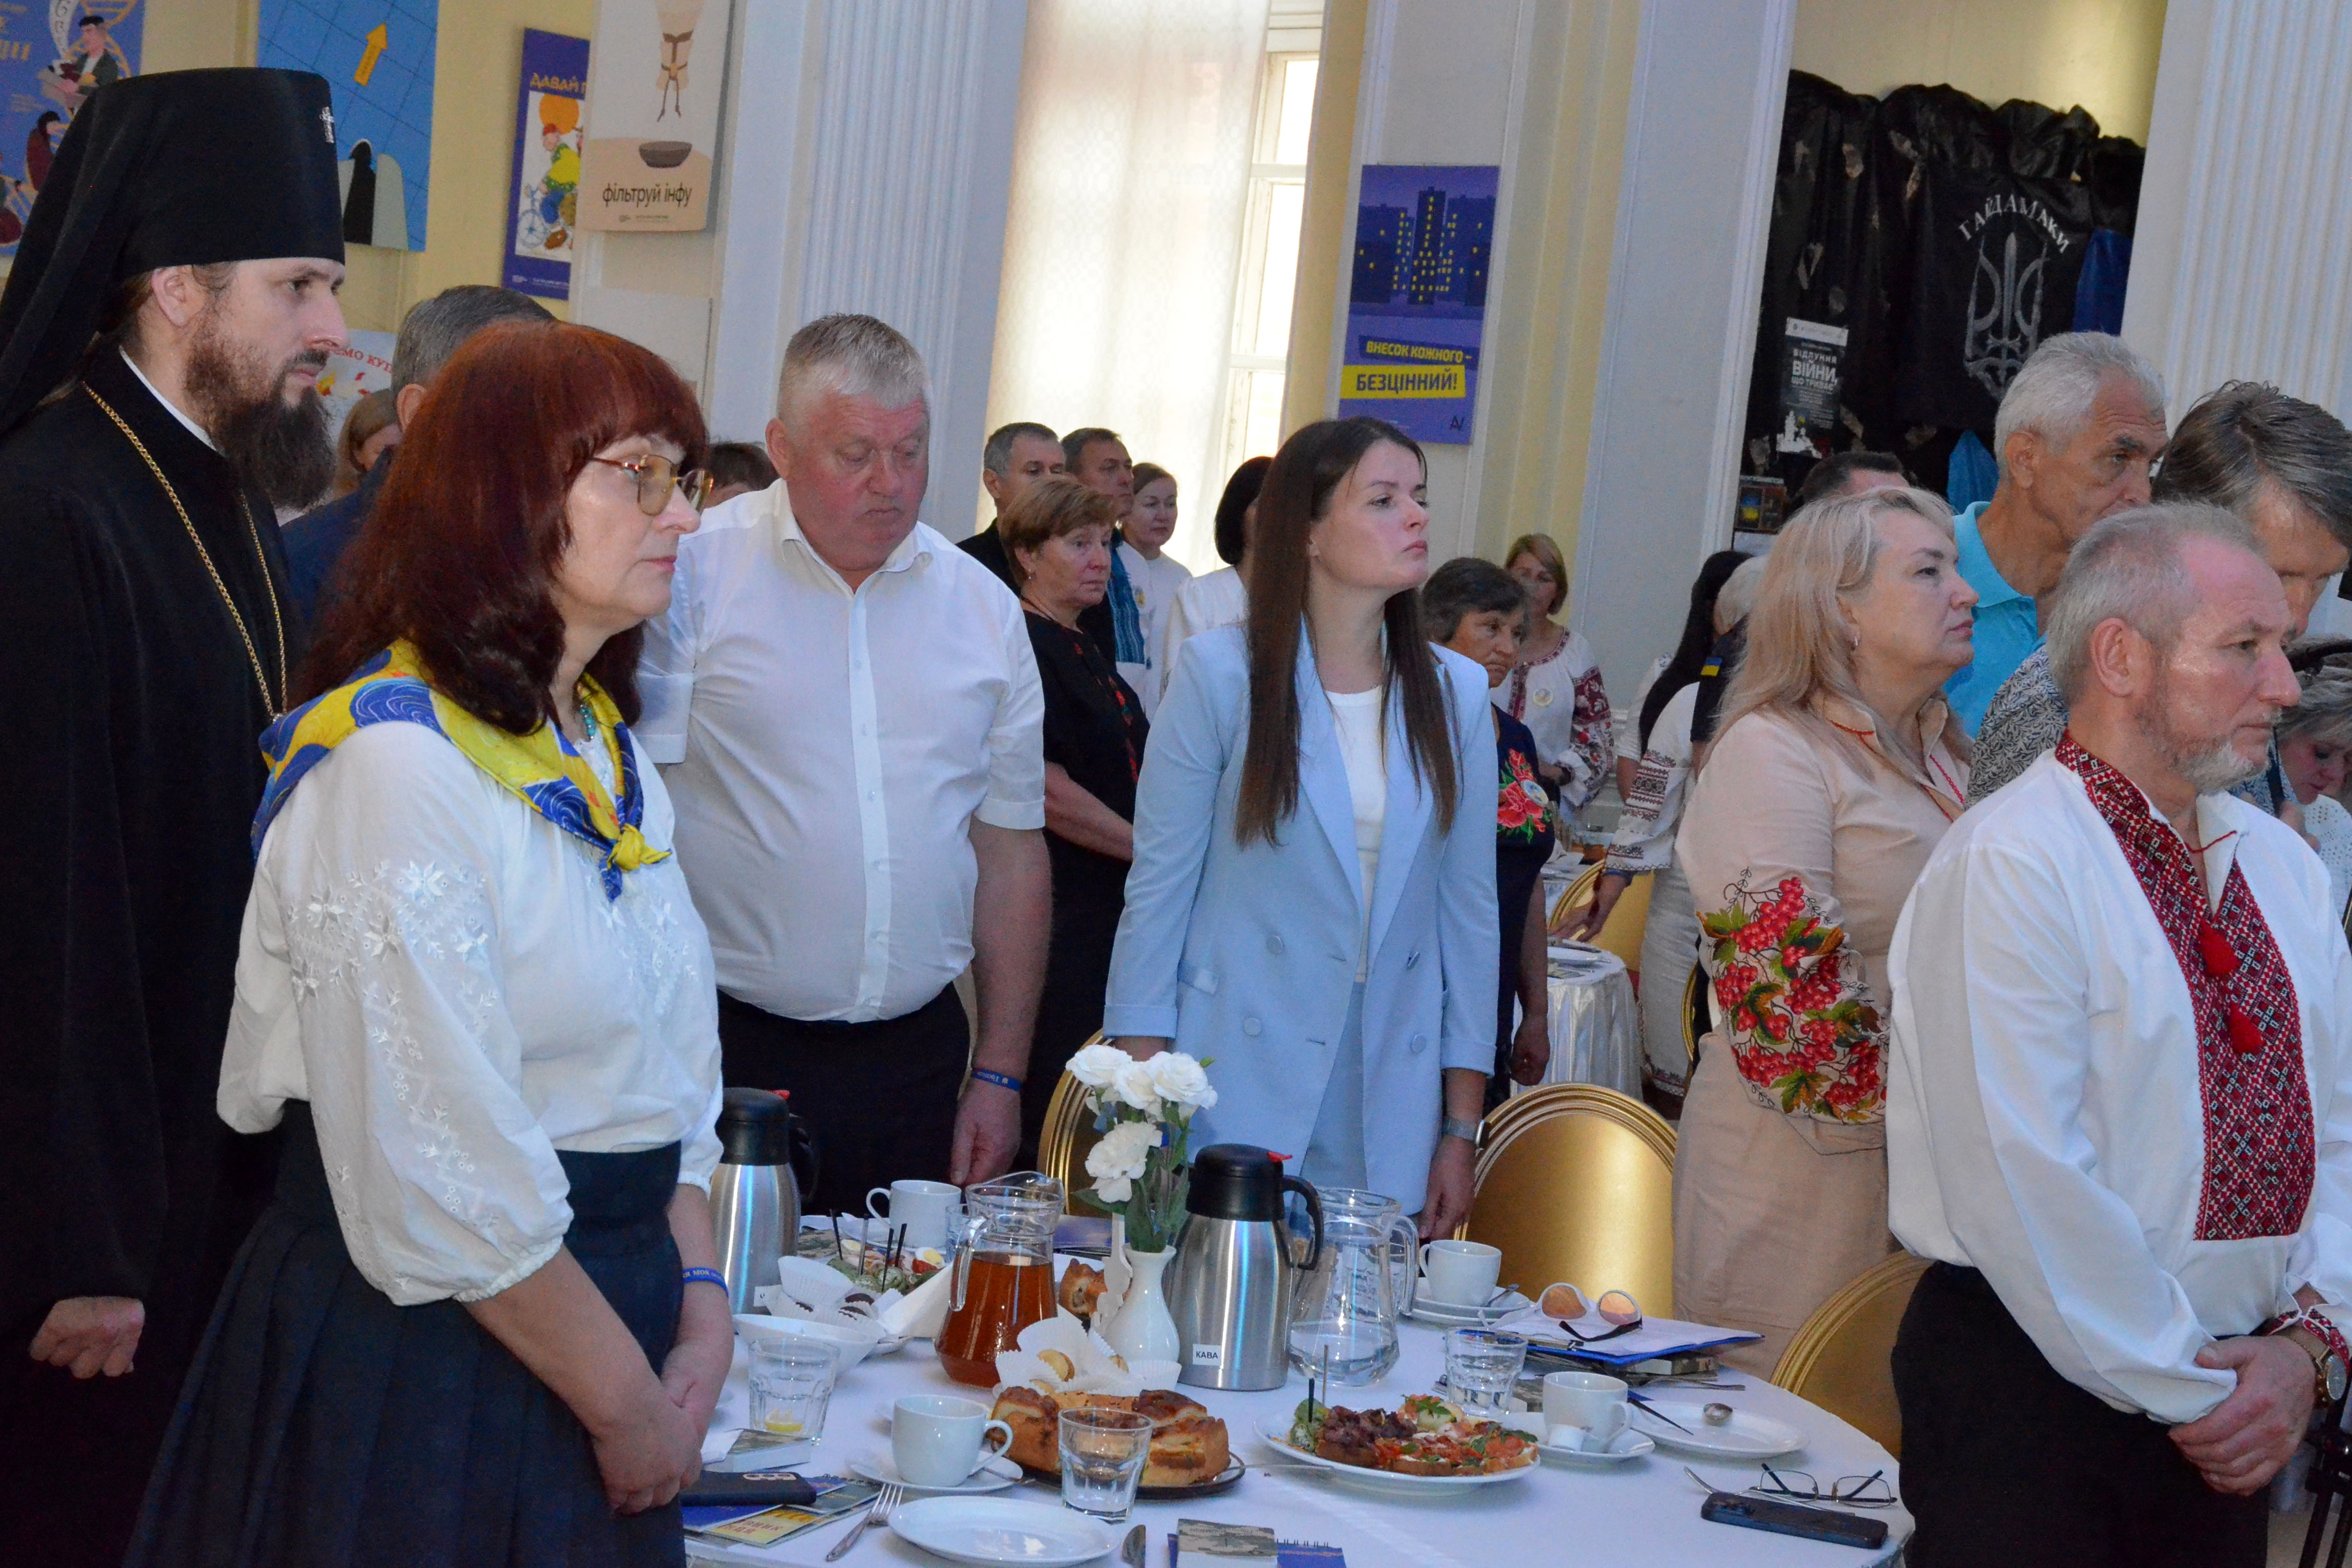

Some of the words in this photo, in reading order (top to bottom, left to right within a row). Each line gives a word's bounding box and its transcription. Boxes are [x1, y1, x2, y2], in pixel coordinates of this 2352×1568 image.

[602, 182, 661, 208] фільтруй
[664, 182, 692, 208] інфу
[1958, 193, 2070, 254] ГАЙДАМАКИ
[1366, 340, 1409, 357] ВНЕСОК
[1411, 345, 1464, 363] КОЖНОГО
[1356, 368, 1458, 394] БЕЗЦІННИЙ!
[1792, 359, 1838, 384] ВІЙНИ,
[1196, 1351, 1218, 1359] КАВА
